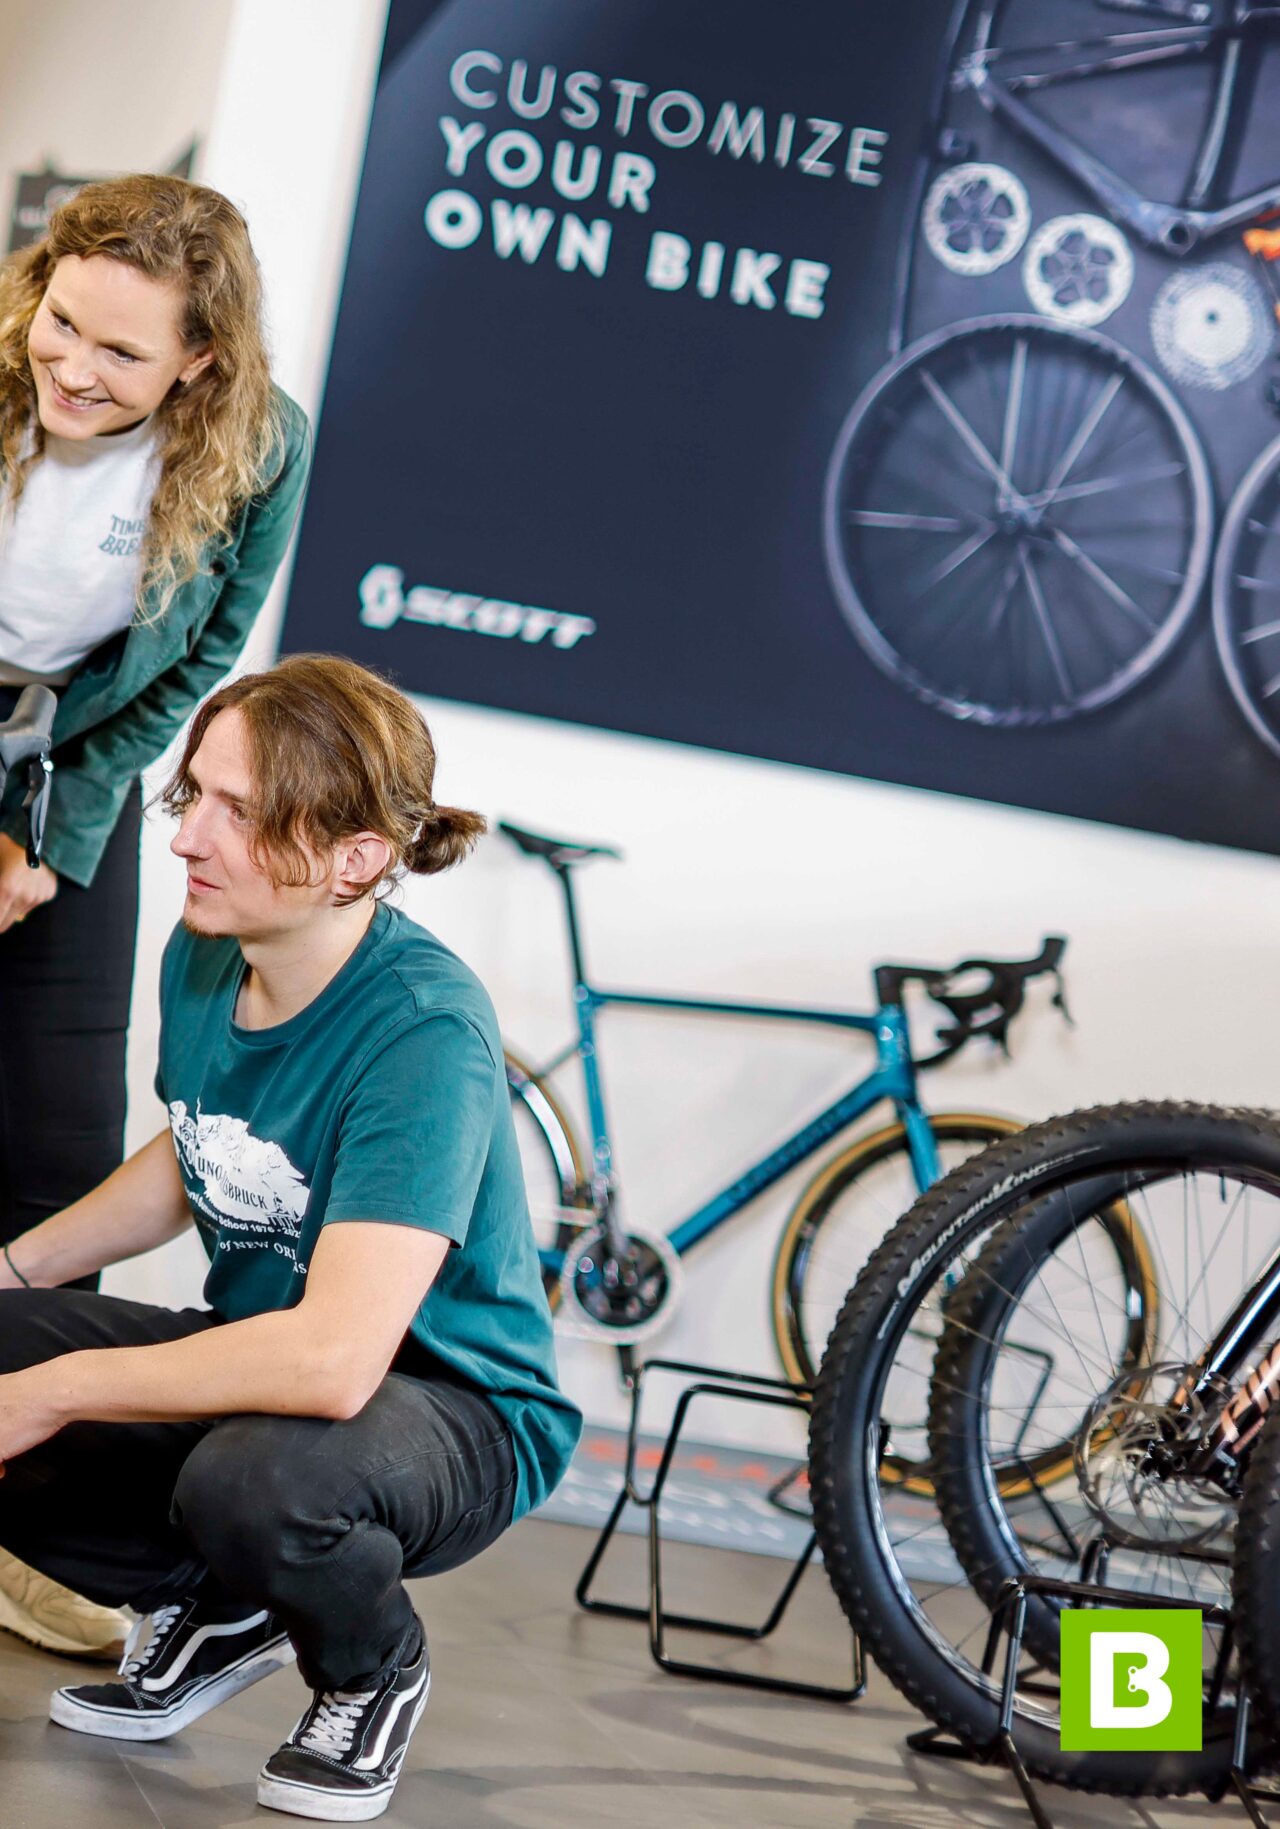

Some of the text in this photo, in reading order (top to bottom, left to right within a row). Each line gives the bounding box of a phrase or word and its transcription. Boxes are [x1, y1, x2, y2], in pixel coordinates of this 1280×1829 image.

[438, 115, 656, 213] YOUR
[449, 49, 888, 186] CUSTOMIZE
[424, 188, 831, 319] OWN BIKE
[99, 533, 140, 556] BRE
[404, 586, 595, 649] SCOTT
